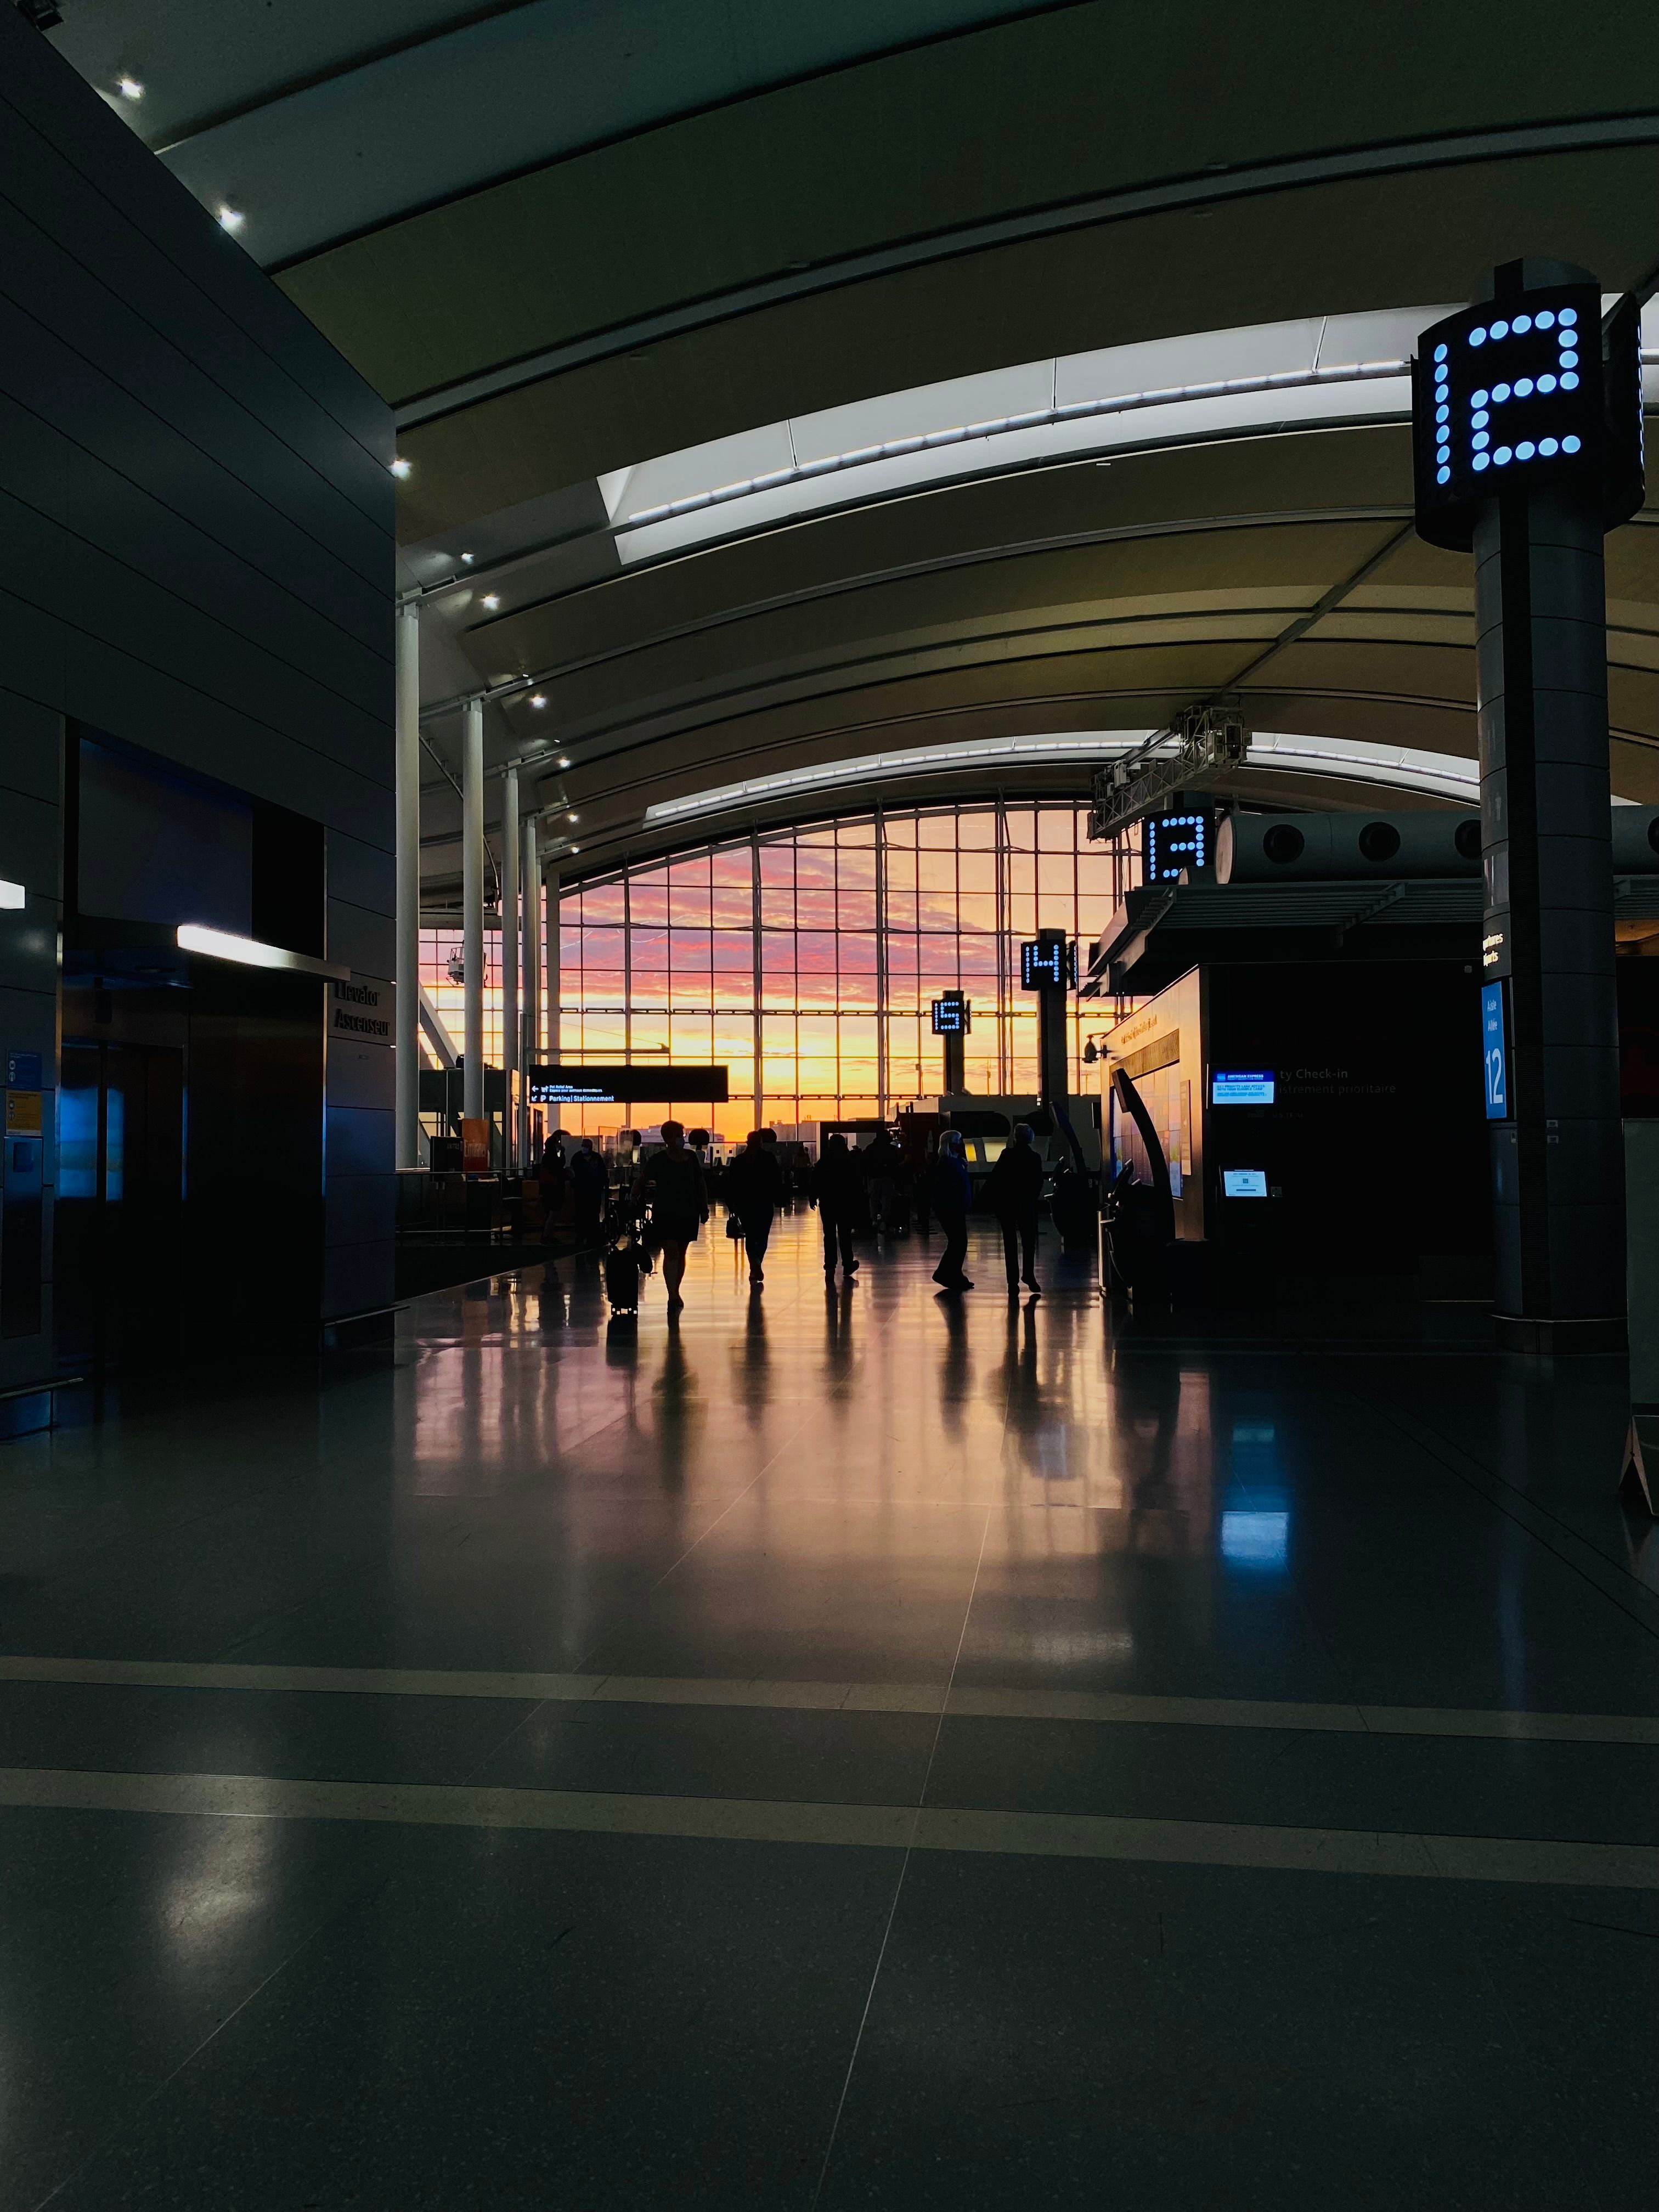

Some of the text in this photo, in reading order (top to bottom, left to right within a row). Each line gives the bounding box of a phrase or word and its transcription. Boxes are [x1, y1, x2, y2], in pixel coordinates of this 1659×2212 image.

[1433, 307, 1582, 485] 12
[1149, 815, 1205, 881] 13
[1025, 944, 1059, 984] 14
[334, 1008, 390, 1036] Ascenseur
[934, 1001, 960, 1030] 15
[1296, 1068, 1348, 1079] Check-in
[1338, 1084, 1397, 1097] prioritaire
[1486, 1048, 1503, 1104] 12
